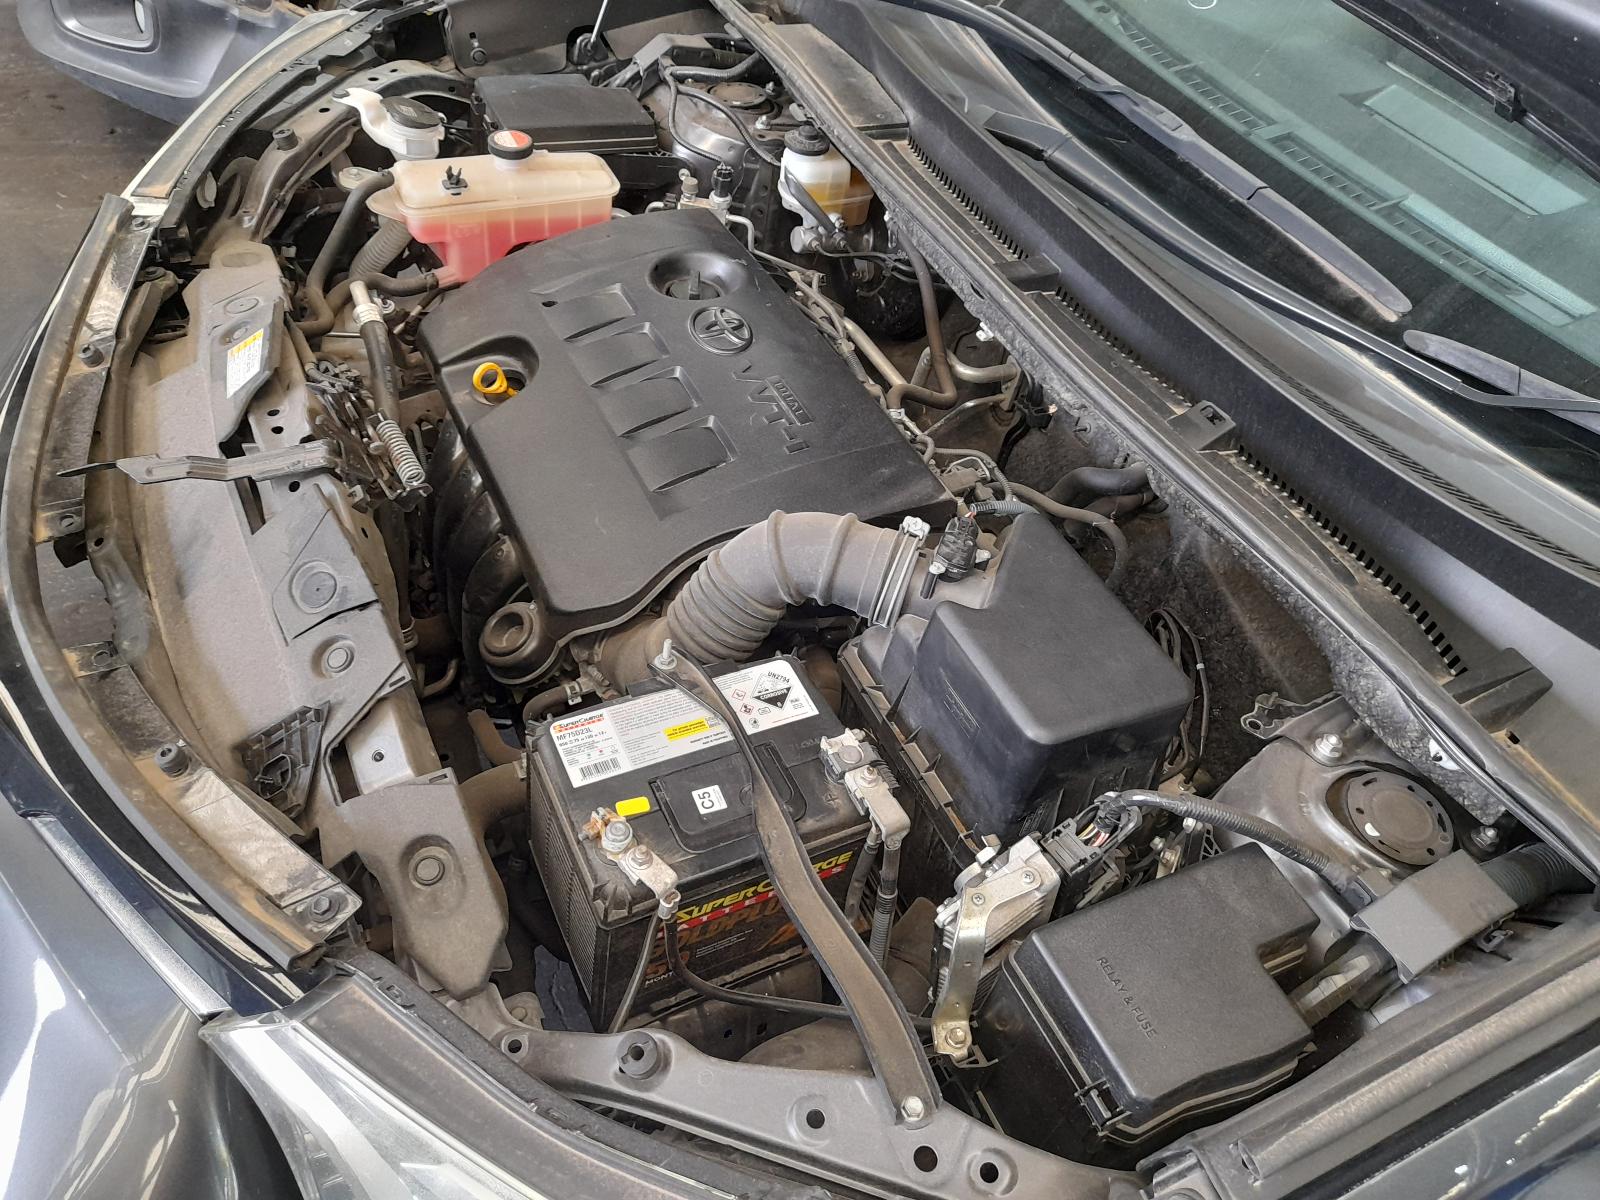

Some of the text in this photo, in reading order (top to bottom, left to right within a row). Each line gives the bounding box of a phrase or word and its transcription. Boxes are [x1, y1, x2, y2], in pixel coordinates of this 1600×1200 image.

[767, 671, 790, 683] UN2794
[697, 791, 715, 809] C5
[1096, 956, 1158, 1039] RELAY & FUSE
